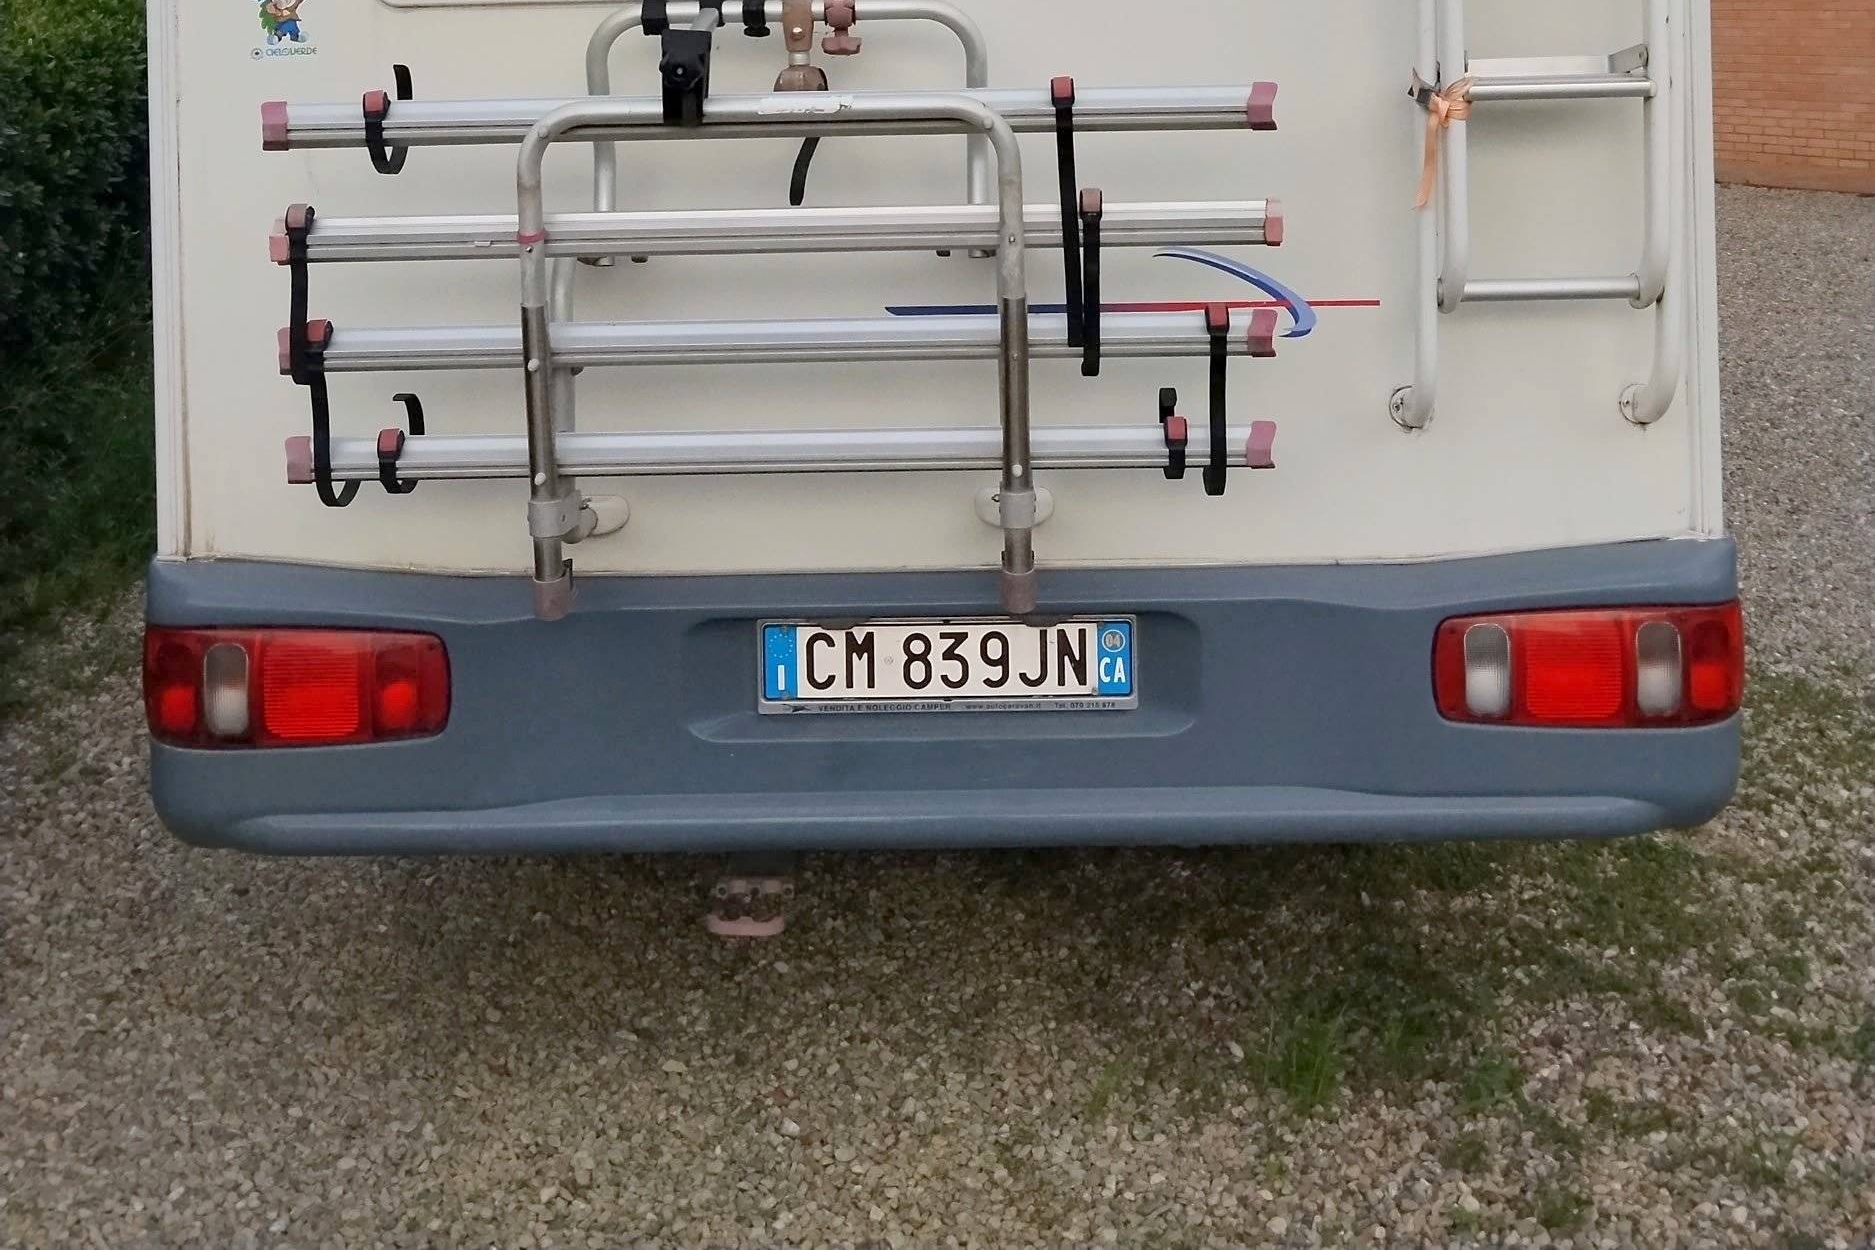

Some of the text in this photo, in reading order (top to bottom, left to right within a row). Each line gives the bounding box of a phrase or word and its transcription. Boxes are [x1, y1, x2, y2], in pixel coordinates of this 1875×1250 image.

[805, 630, 876, 690] CM
[1099, 656, 1126, 683] CA
[818, 704, 855, 712] VENDITA
[866, 703, 913, 711] NOLEGGIO
[914, 703, 952, 711] CAMPER
